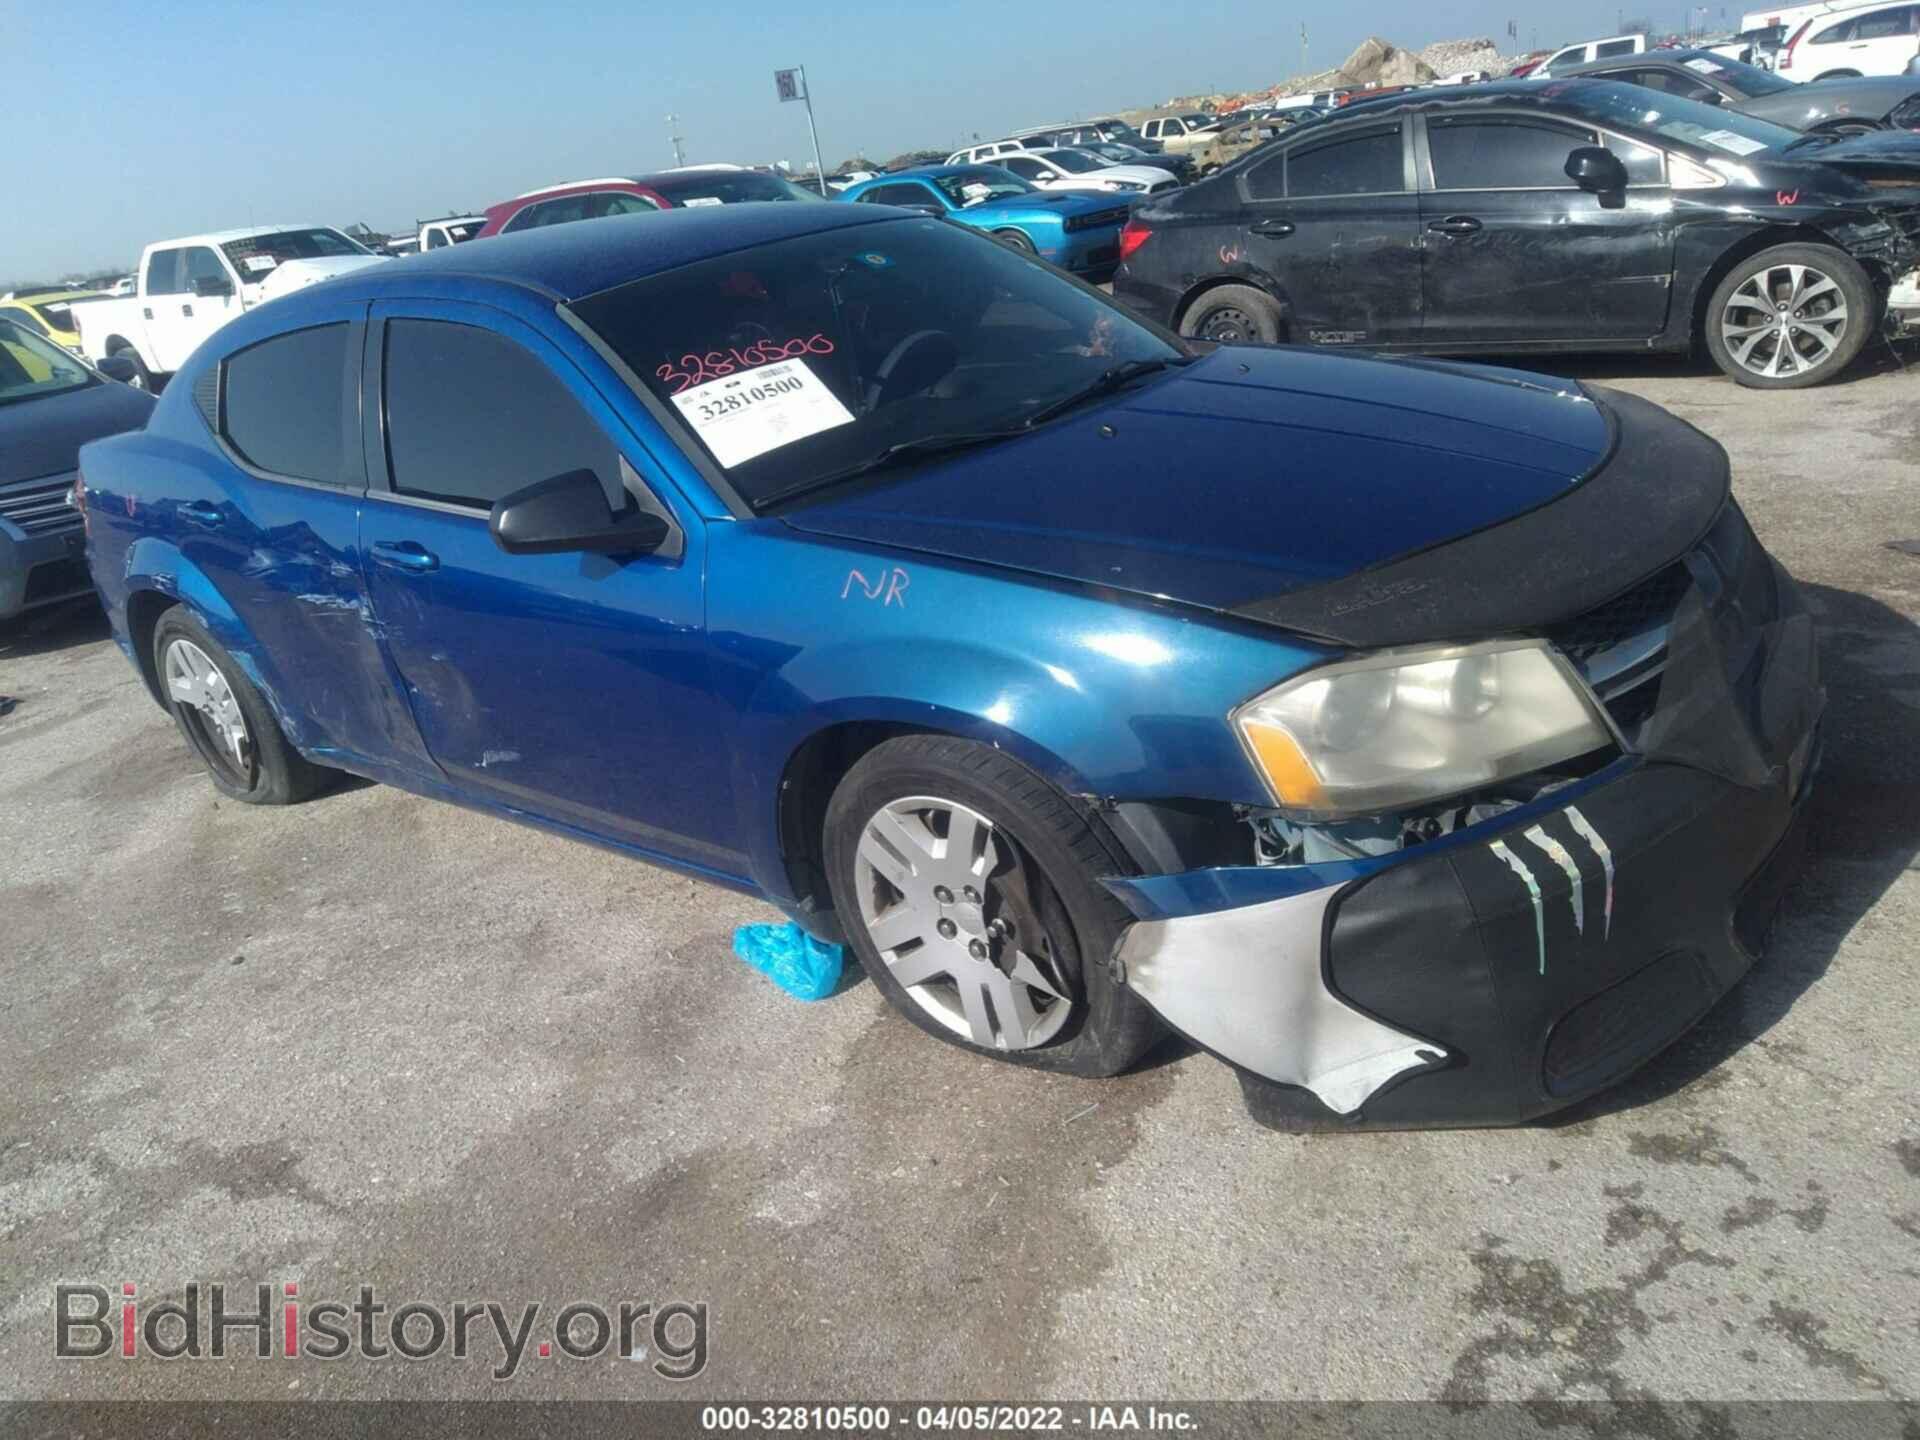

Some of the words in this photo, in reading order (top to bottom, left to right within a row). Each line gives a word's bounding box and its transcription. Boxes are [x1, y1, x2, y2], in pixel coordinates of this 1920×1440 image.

[655, 334, 834, 395] 32810500
[698, 376, 804, 420] 32810500
[841, 567, 910, 608] NR
